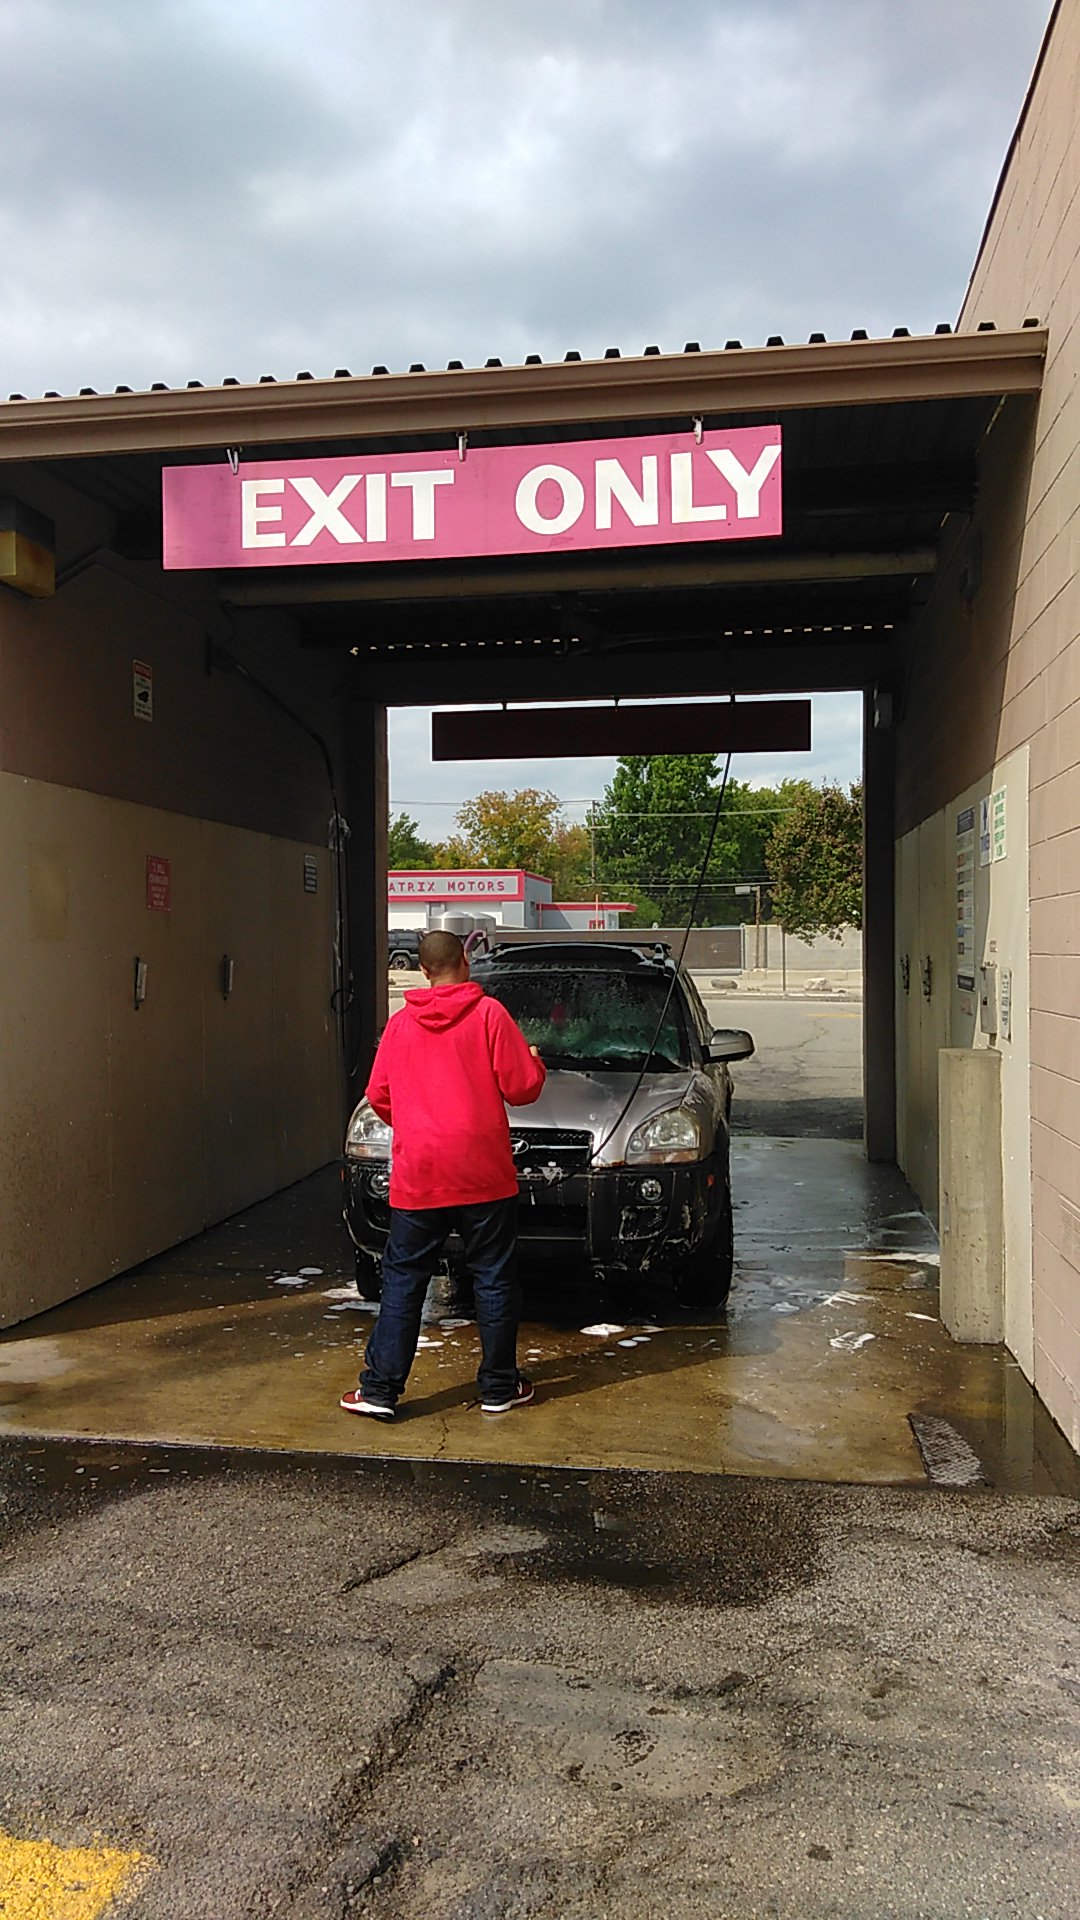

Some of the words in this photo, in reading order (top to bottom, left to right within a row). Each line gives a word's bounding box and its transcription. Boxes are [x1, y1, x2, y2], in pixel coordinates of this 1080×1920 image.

[241, 469, 454, 549] EXIT
[515, 445, 782, 535] ONLY
[388, 880, 434, 892] ATRIX
[447, 880, 505, 891] MOTORS
